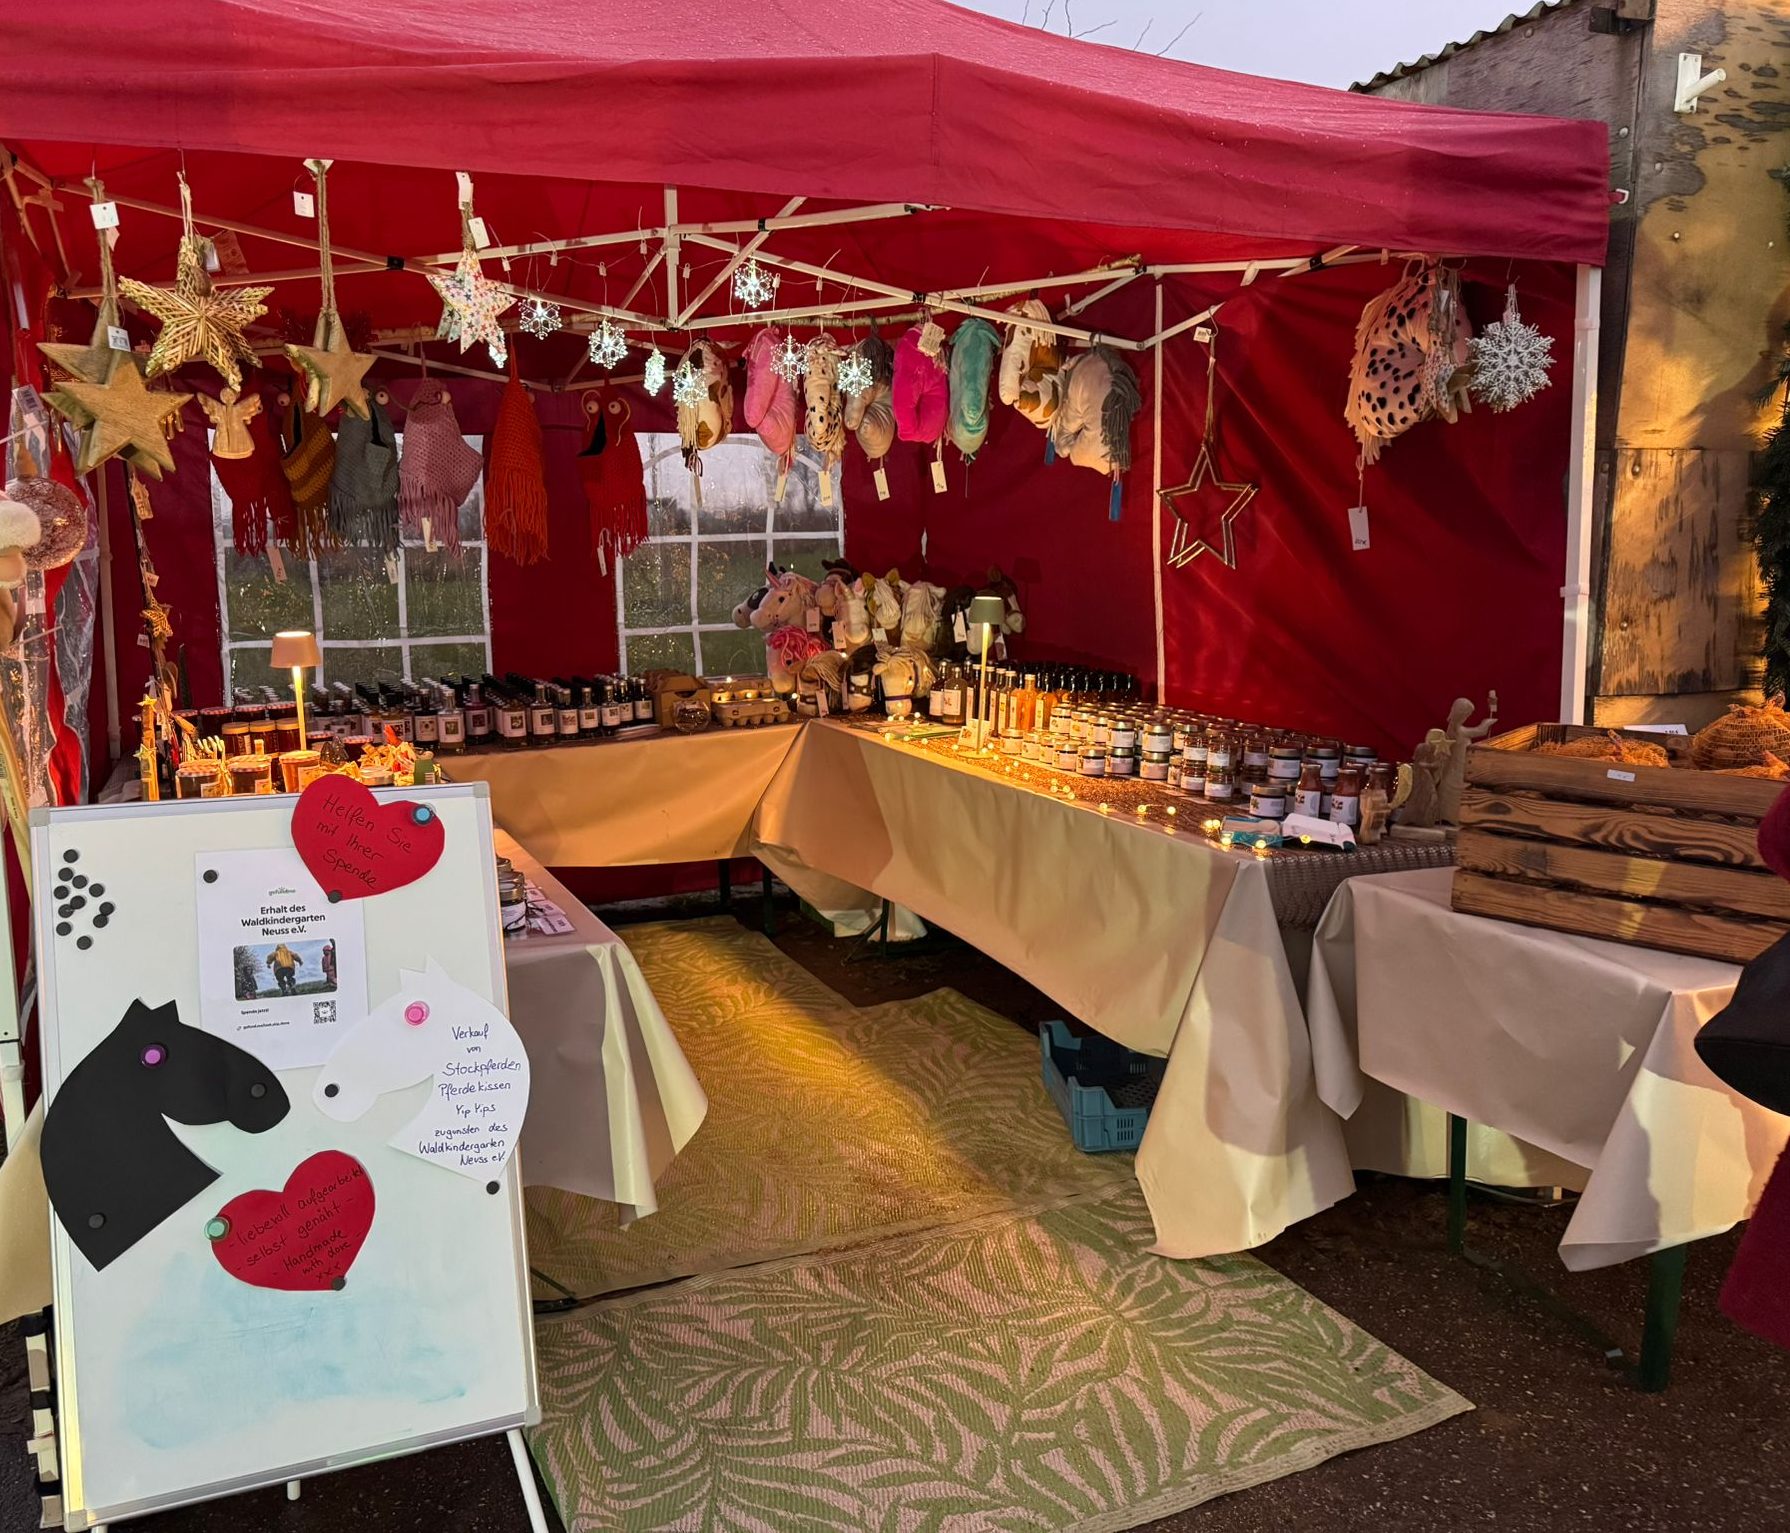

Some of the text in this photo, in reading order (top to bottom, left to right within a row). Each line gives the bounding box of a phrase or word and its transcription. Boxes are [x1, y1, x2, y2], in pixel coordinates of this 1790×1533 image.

[322, 793, 413, 853] Helfen Sie
[316, 822, 384, 861] mit Ihrer
[323, 848, 377, 889] Spende
[260, 904, 306, 915] Erhalt des
[241, 914, 326, 927] Waldkindergarten
[262, 925, 307, 937] Neuss e.V.
[452, 1023, 489, 1040] Verkauf
[466, 1045, 481, 1053] von
[442, 1058, 521, 1076] Stockpferden
[435, 1122, 509, 1139] zugunsten des
[419, 1138, 505, 1154] Waldkindergarten
[460, 1154, 489, 1166] Neuss
[236, 1203, 291, 1246] liebevoll
[246, 1200, 342, 1267] selbst genäht
[283, 1229, 347, 1273] Handmade
